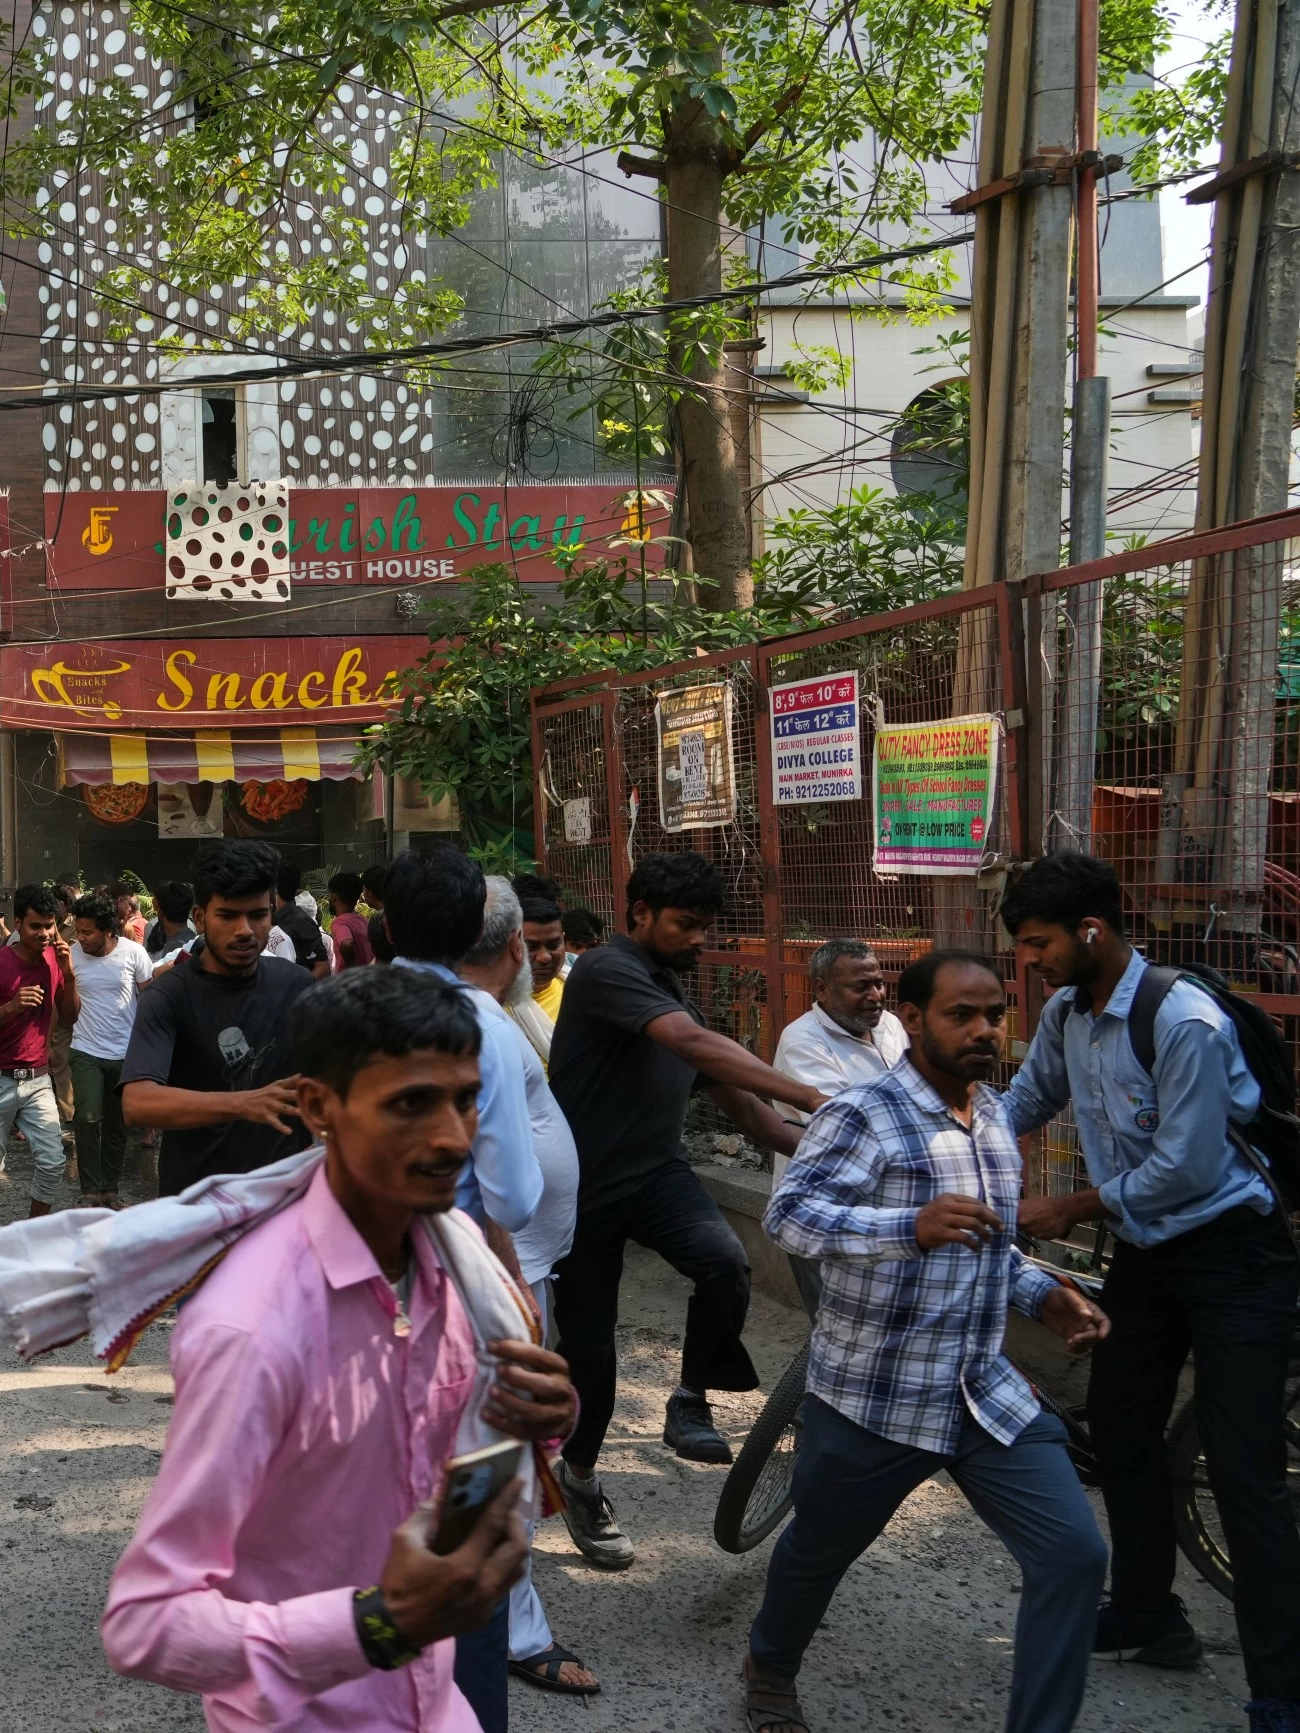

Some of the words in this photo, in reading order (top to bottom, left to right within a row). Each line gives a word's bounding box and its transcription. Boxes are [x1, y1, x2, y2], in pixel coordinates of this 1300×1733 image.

[445, 492, 590, 570] Stay
[290, 559, 355, 580] UEST
[367, 559, 455, 579] HOUSE
[67, 676, 107, 688] Snacks
[75, 694, 104, 706] Bites
[806, 735, 830, 747] REGULAR
[831, 732, 854, 744] CLASSES
[900, 733, 931, 760] FANCY
[932, 730, 961, 758] DRESS
[962, 728, 989, 756] ZONE
[688, 753, 699, 765] ON
[777, 753, 806, 770] DIVYA
[808, 747, 854, 767] COLLEGE
[778, 773, 793, 783] MAIN
[821, 767, 854, 779] MUNIRKA
[779, 786, 794, 800] PH:
[795, 781, 855, 799] 9212252068
[926, 822, 943, 837] LOW
[944, 822, 965, 837] PRICE
